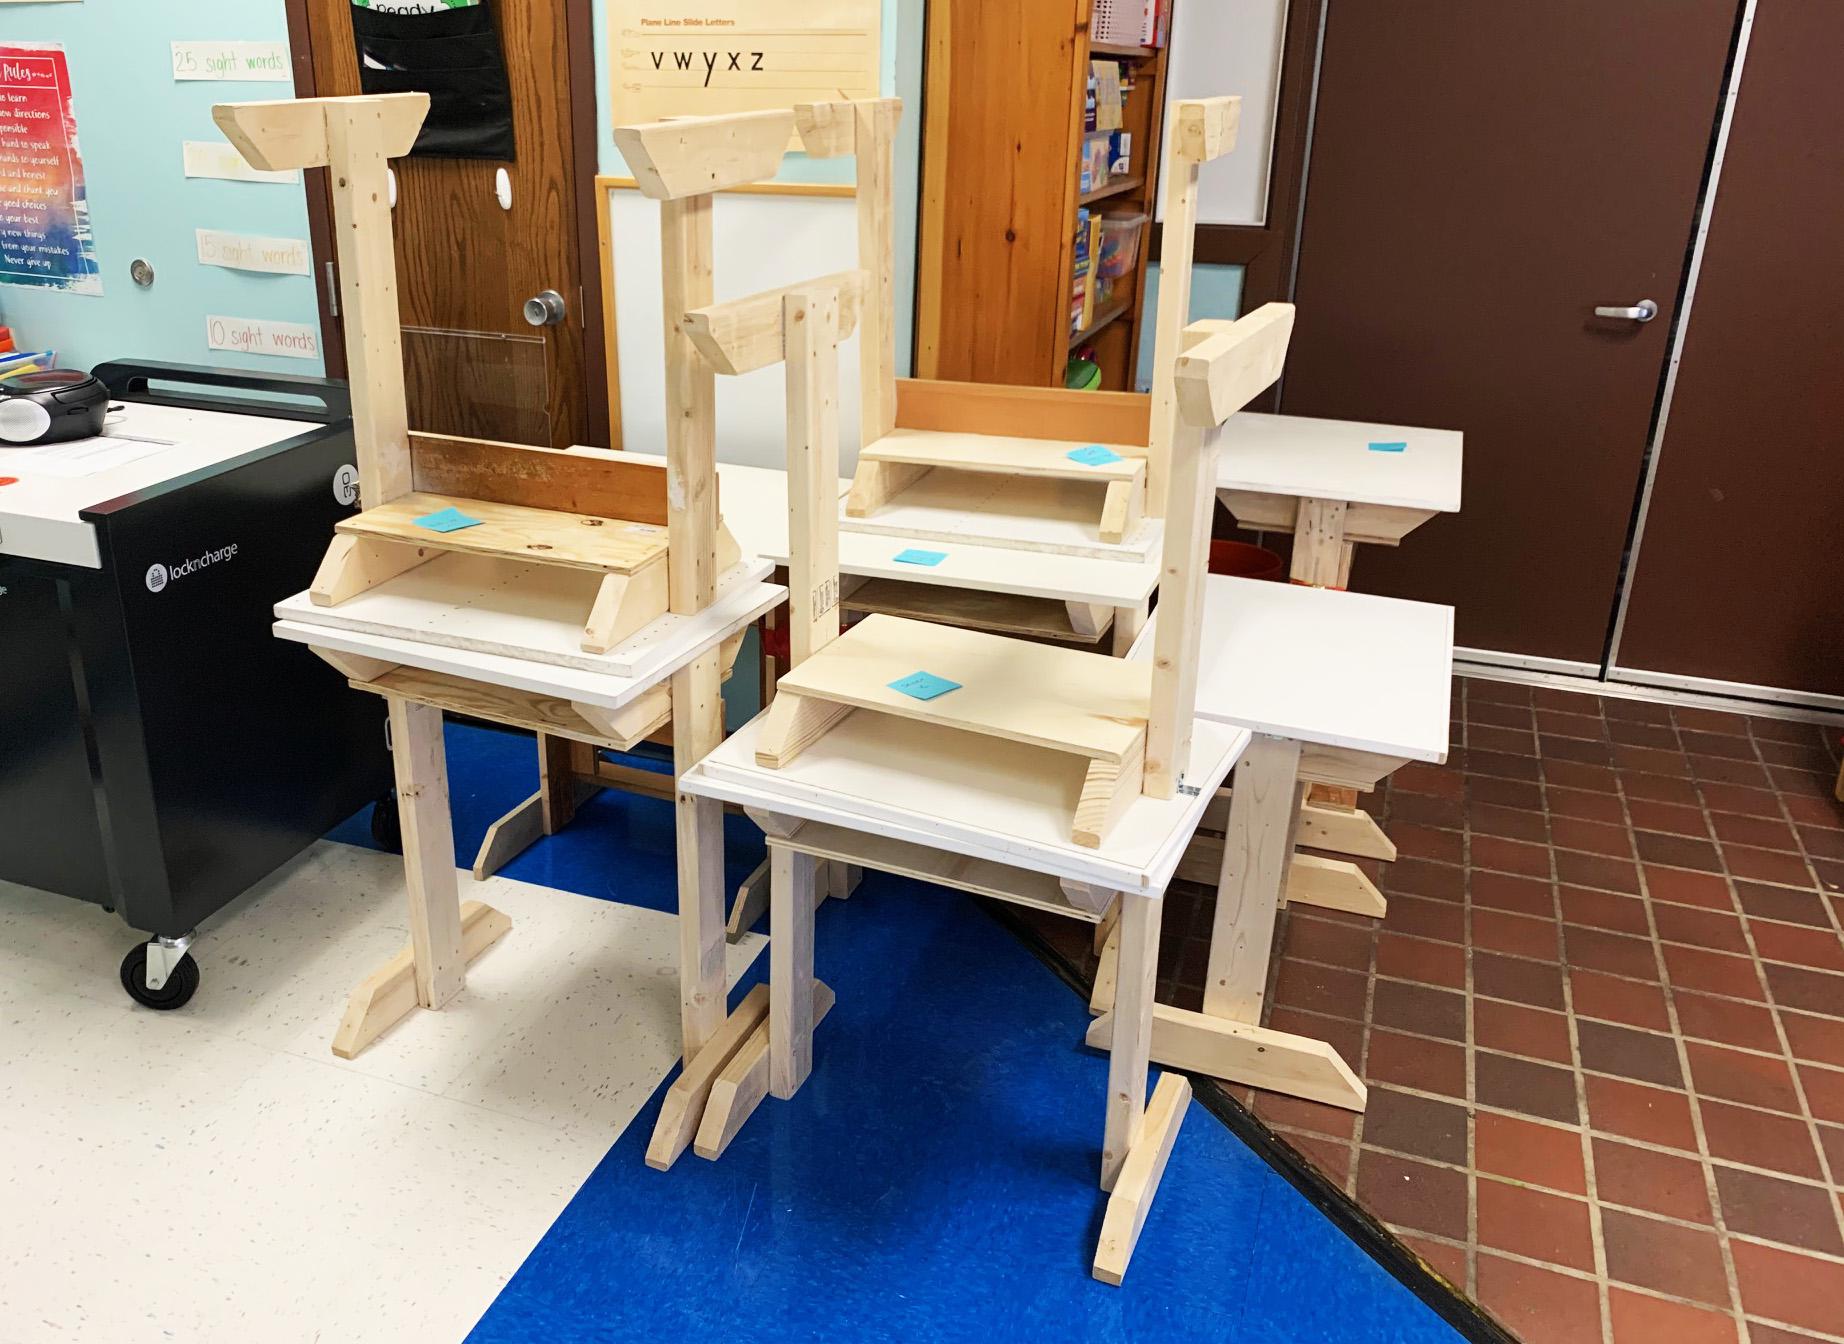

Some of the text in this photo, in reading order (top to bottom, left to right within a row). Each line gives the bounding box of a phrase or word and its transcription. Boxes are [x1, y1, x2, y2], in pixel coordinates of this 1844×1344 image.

[641, 18, 735, 27] Plane Line Slide Letters
[175, 50, 284, 78] 25 sight words
[651, 51, 764, 88] v w y x z
[3, 62, 31, 81] Rules
[7, 92, 28, 103] learn
[14, 107, 51, 119] directions
[31, 140, 51, 152] speak
[31, 155, 59, 167] yourself
[3, 198, 47, 211] good choices
[6, 215, 21, 225] your
[24, 213, 39, 224] best
[24, 228, 46, 241] things
[21, 244, 36, 254] your
[38, 245, 70, 256] mistakes
[4, 254, 51, 270] Never give up
[209, 319, 316, 352] 10 sight words
[169, 543, 238, 581] lockncharge
